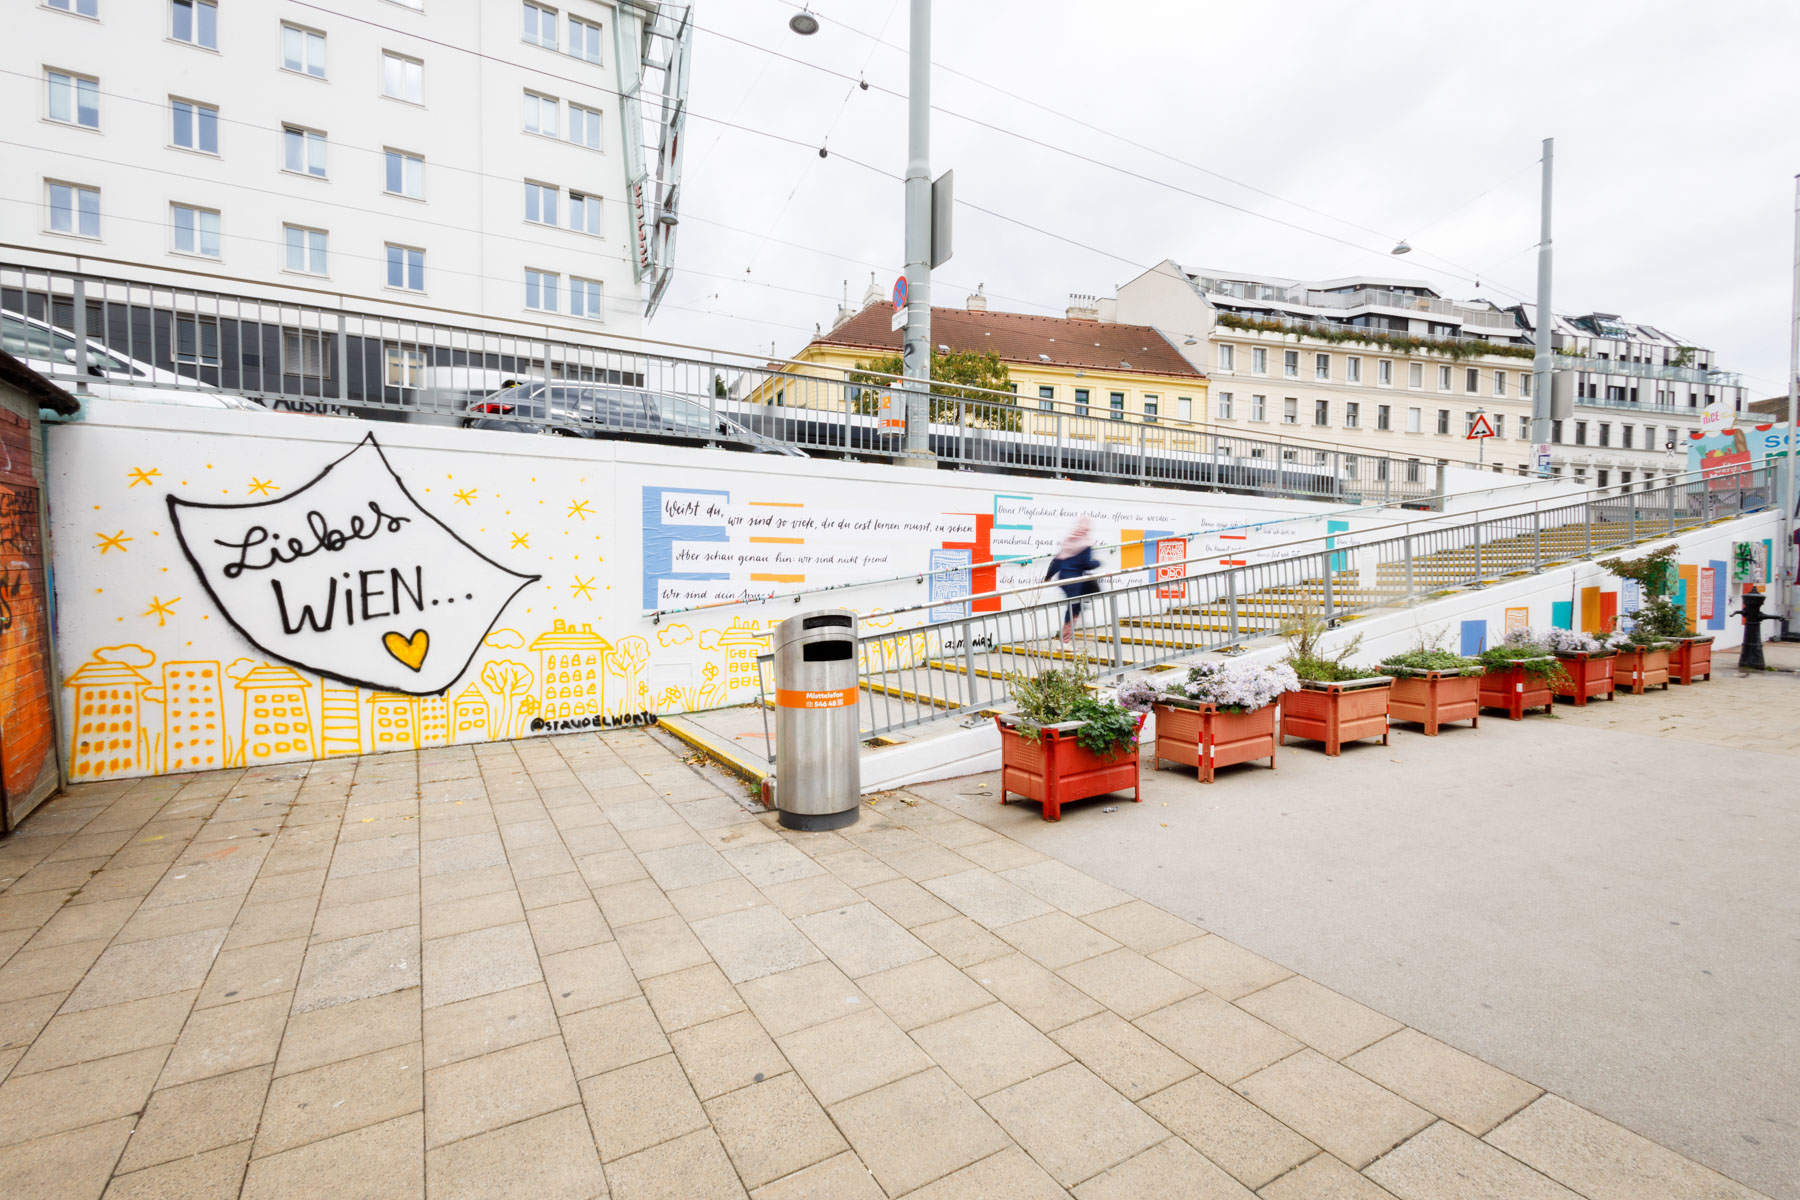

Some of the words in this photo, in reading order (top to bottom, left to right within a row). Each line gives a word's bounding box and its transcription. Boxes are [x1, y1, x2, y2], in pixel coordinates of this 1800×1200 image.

[665, 499, 700, 518] Weißt
[706, 503, 724, 518] du,
[728, 514, 743, 527] wir
[748, 514, 774, 527] sind
[776, 518, 788, 528] so
[792, 518, 818, 531] viele,
[821, 517, 835, 530] die
[837, 517, 851, 529] du
[854, 519, 872, 531] erst
[874, 519, 900, 531] lernen
[214, 501, 411, 578] Liebes
[676, 549, 700, 561] Aber
[704, 551, 734, 562] schau
[738, 555, 769, 566] genau
[816, 555, 834, 565] sind
[837, 555, 858, 565] nicht
[662, 589, 680, 599] Wir
[684, 588, 707, 599] sind
[714, 590, 735, 599] dein
